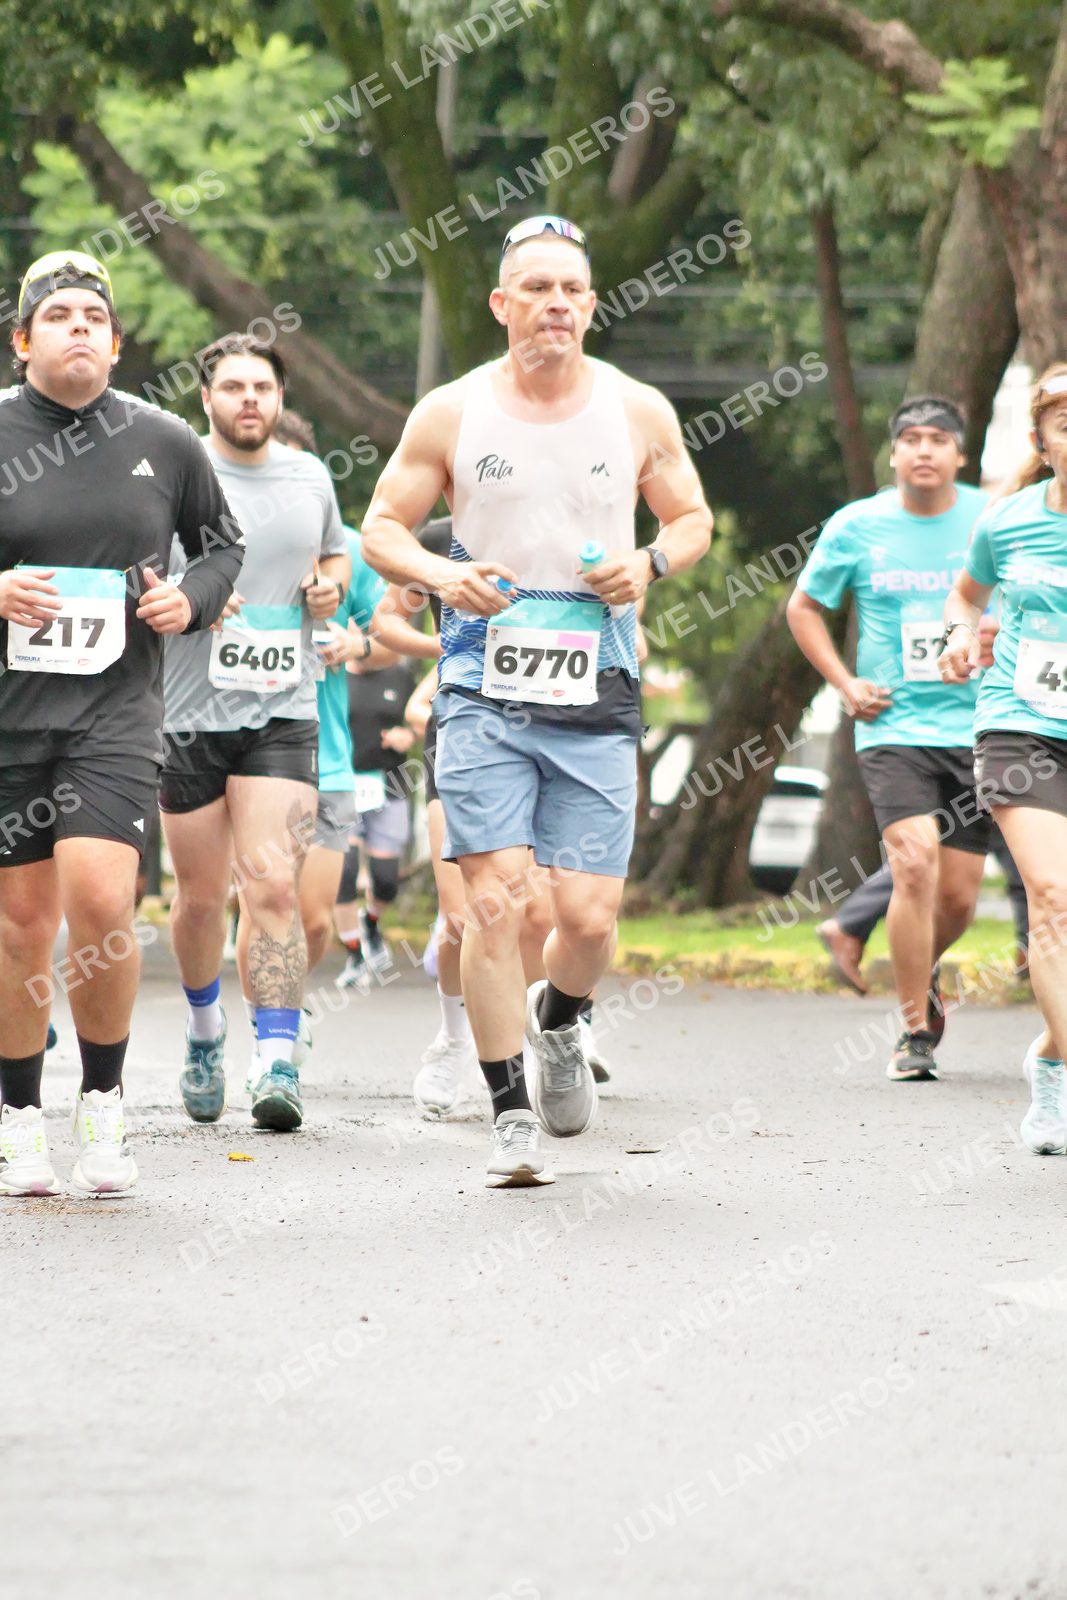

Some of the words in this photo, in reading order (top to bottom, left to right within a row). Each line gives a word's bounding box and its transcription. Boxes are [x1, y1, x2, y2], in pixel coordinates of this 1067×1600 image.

[29, 616, 105, 648] 217
[219, 643, 295, 672] 6405
[493, 645, 589, 680] 6770
